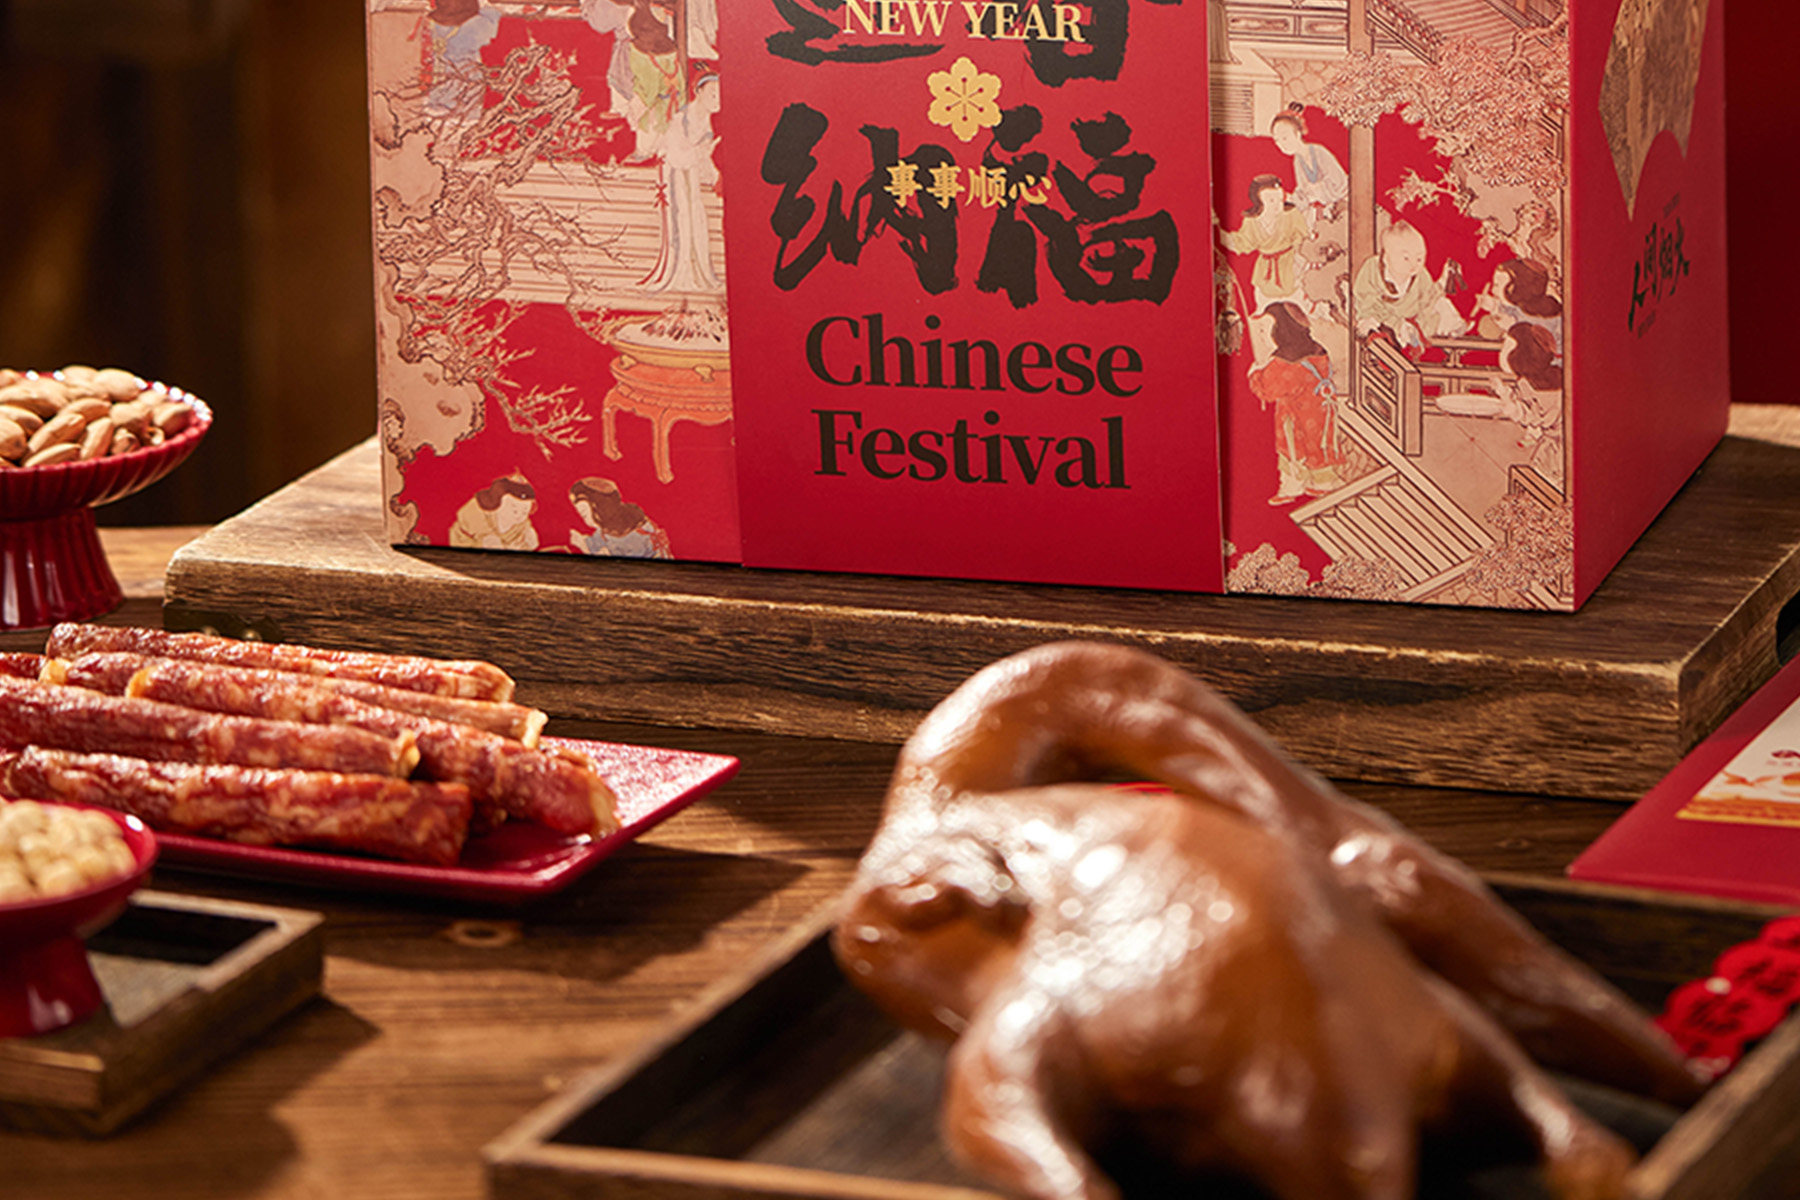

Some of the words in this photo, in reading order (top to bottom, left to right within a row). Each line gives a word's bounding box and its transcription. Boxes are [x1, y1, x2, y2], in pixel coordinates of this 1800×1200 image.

[961, 1, 1086, 43] YEAR
[761, 102, 1180, 309] 纳福
[883, 160, 1052, 209] 事事顺心
[805, 313, 1144, 397] Chinese
[811, 408, 1132, 490] Festival
